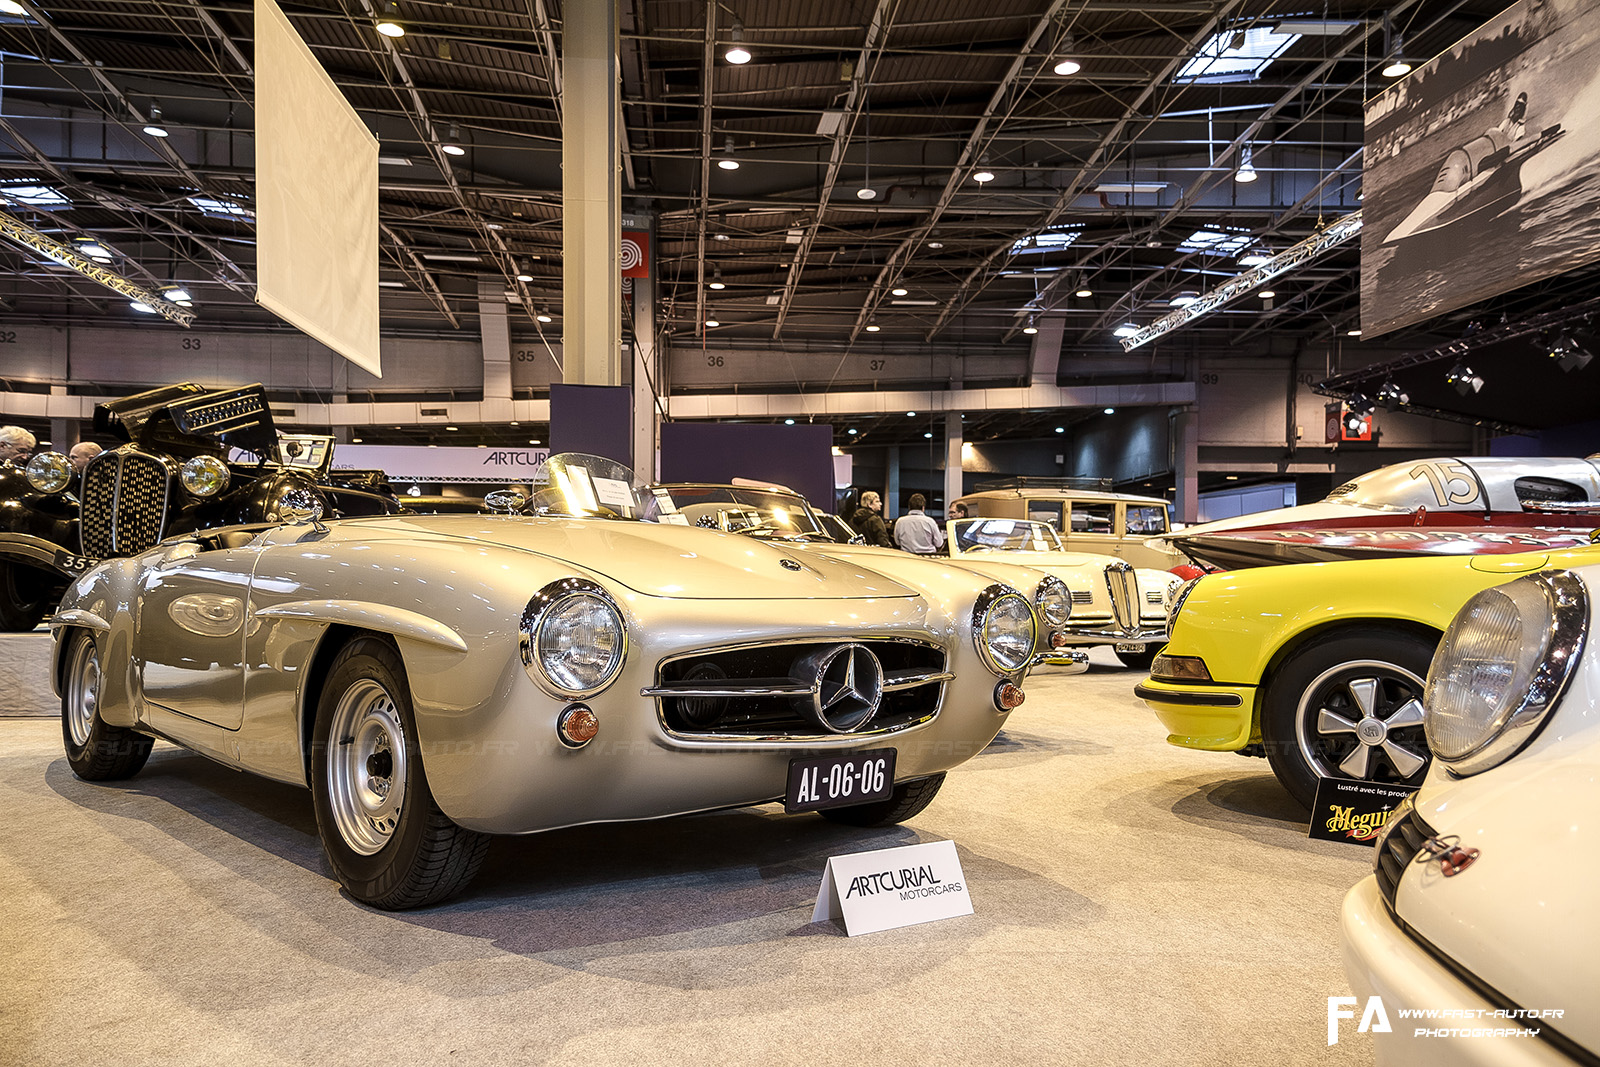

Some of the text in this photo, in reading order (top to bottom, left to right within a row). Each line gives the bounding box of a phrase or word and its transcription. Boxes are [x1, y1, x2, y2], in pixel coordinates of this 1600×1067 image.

[182, 338, 201, 350] 33
[517, 350, 535, 362] 35
[707, 356, 724, 367] 36
[870, 359, 885, 371] 37
[1202, 374, 1218, 385] 39
[1409, 462, 1480, 507] 15
[797, 758, 886, 803] AL-06-06
[1337, 784, 1359, 793] Lustré
[1360, 787, 1376, 795] avec
[1326, 804, 1395, 838] Megui
[899, 882, 963, 901] MOTORCARS
